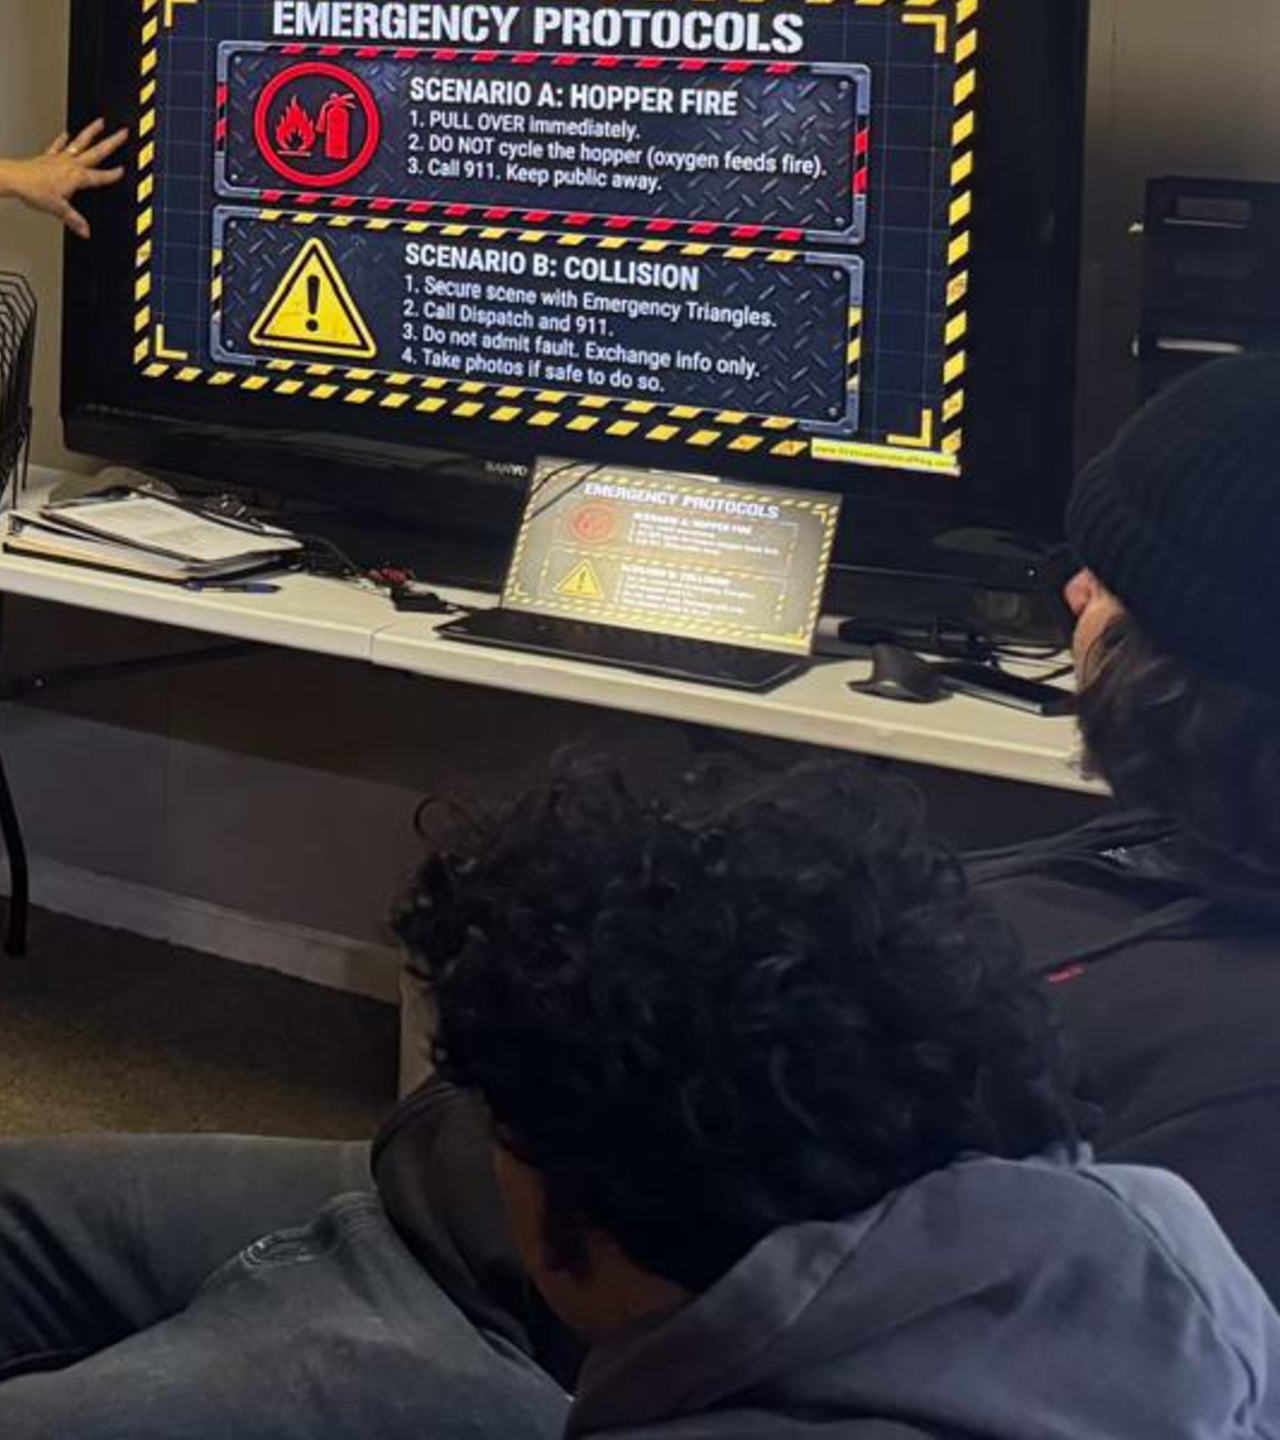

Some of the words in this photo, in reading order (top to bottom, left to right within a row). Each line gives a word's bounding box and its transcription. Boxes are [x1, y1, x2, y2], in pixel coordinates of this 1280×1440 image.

[272, 0, 520, 45] EMERGENCY
[532, 6, 805, 54] PROTOCOLS
[409, 76, 532, 107] SCENARIO
[537, 82, 564, 109] A:
[570, 84, 674, 114] HOPPER
[680, 88, 738, 117] FIRE
[408, 110, 425, 128] 1.
[429, 111, 474, 130] PULL
[477, 114, 526, 133] OVER
[529, 116, 641, 142] immediately.
[407, 134, 424, 151] 2.
[429, 135, 454, 153] DO
[458, 137, 495, 155] NOT
[498, 139, 543, 160] cycle
[547, 141, 576, 160] the
[580, 143, 642, 166] hopper
[647, 146, 719, 171] (oxygen
[724, 151, 777, 173] feeds
[782, 153, 827, 179] fire).
[407, 157, 423, 175] 3.
[428, 158, 460, 177] Call
[464, 160, 501, 181] 911.
[506, 164, 549, 187] Keep
[553, 166, 607, 188] public
[611, 173, 663, 194] away.
[405, 242, 526, 275] SCENARIO
[532, 253, 558, 278] B:
[564, 256, 699, 291] COLLISION
[402, 299, 420, 318] 2.
[423, 302, 455, 321] Call
[459, 305, 534, 328] Dispatch
[539, 314, 571, 333] and
[575, 316, 614, 337] 911.
[403, 274, 420, 294] 1.
[423, 276, 482, 299] Secure
[486, 283, 537, 305] scene
[541, 288, 578, 309] with
[583, 292, 681, 322] Emergency
[686, 301, 778, 328] Triangles.
[401, 347, 417, 364] 4.
[422, 348, 461, 370] Take
[465, 353, 524, 377] photos
[528, 360, 541, 378] if
[545, 364, 583, 383] safe
[587, 368, 606, 385] to
[609, 369, 632, 388] do
[637, 376, 665, 392] so.
[402, 323, 418, 340] 3.
[422, 325, 446, 343] Do
[449, 330, 477, 347] not
[481, 332, 530, 353] admit
[535, 335, 581, 358] fault.
[585, 341, 671, 370] Exchange
[676, 350, 712, 373] info
[716, 356, 761, 380] only.
[584, 482, 680, 505] EMERGENCY
[682, 494, 780, 519] PROTOCOLS
